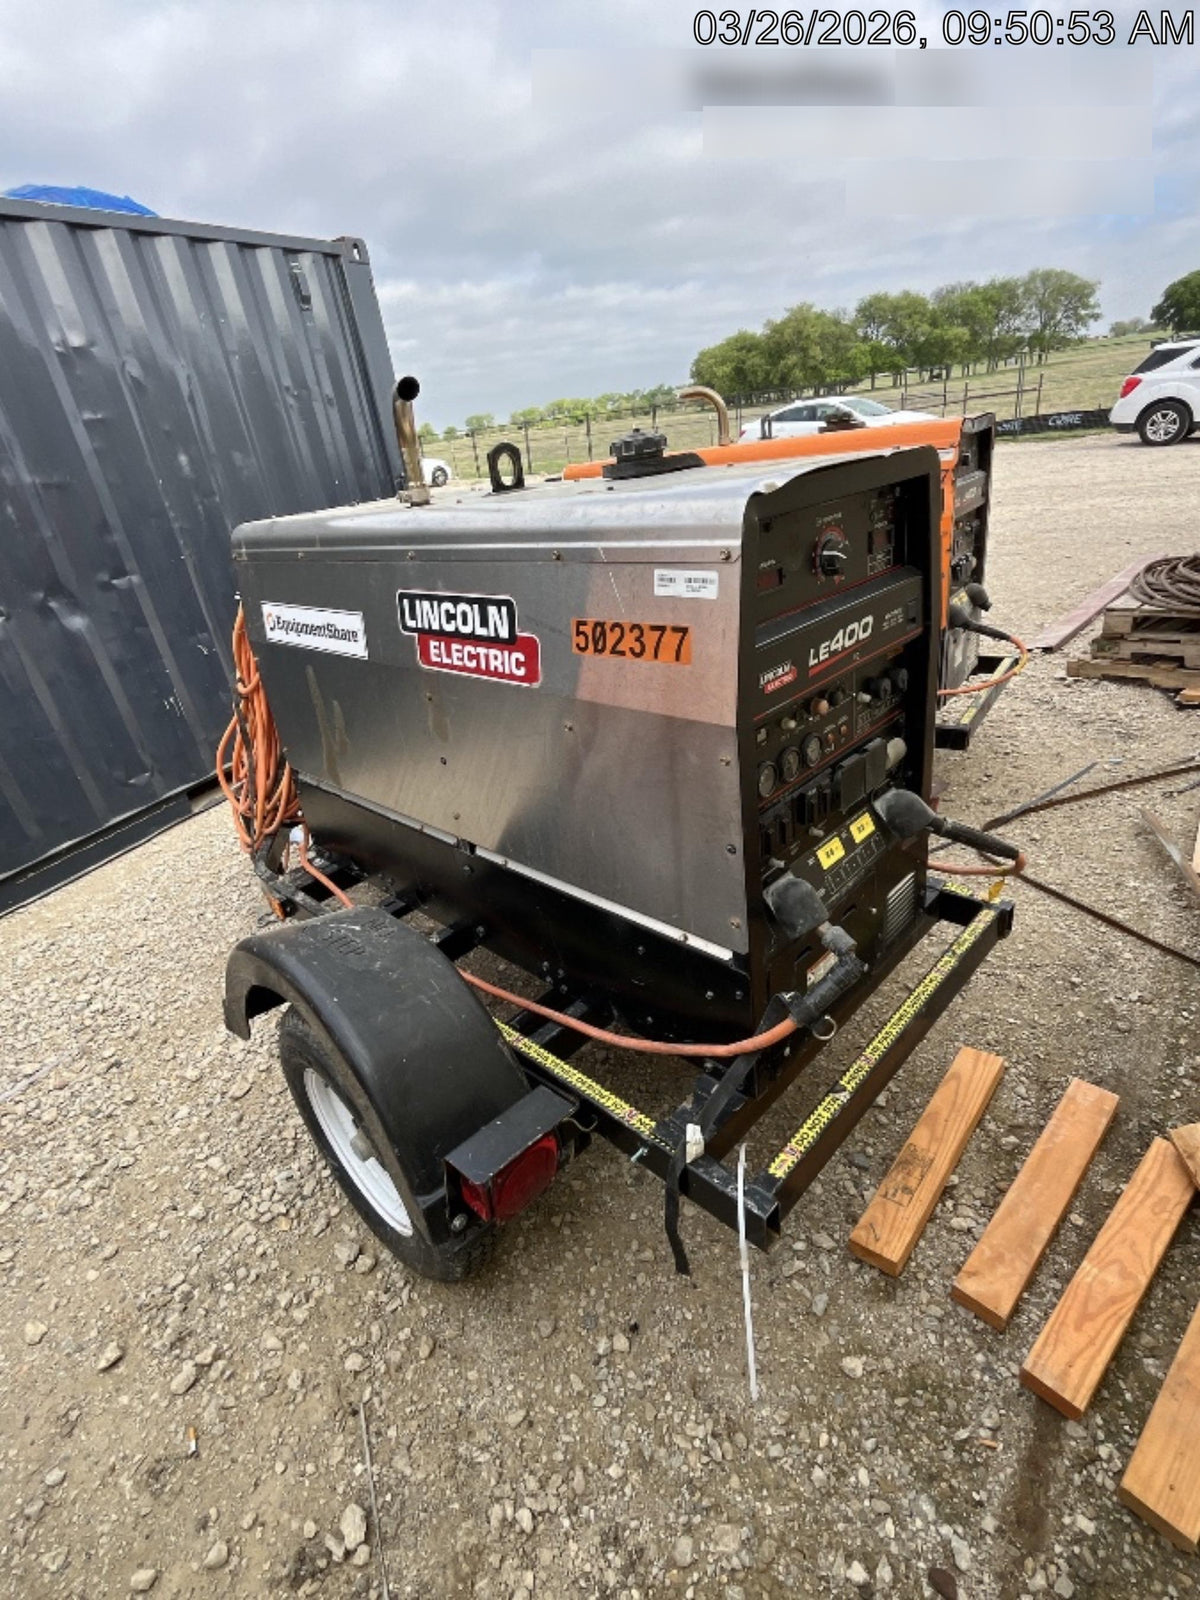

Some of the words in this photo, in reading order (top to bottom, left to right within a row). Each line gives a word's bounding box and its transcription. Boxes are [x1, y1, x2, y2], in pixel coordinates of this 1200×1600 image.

[275, 615, 359, 643] EquipmentShare
[402, 598, 511, 640] LINCOLN
[428, 639, 526, 676] ELECTRIC
[575, 620, 689, 662] 502377
[808, 614, 874, 667] LE400
